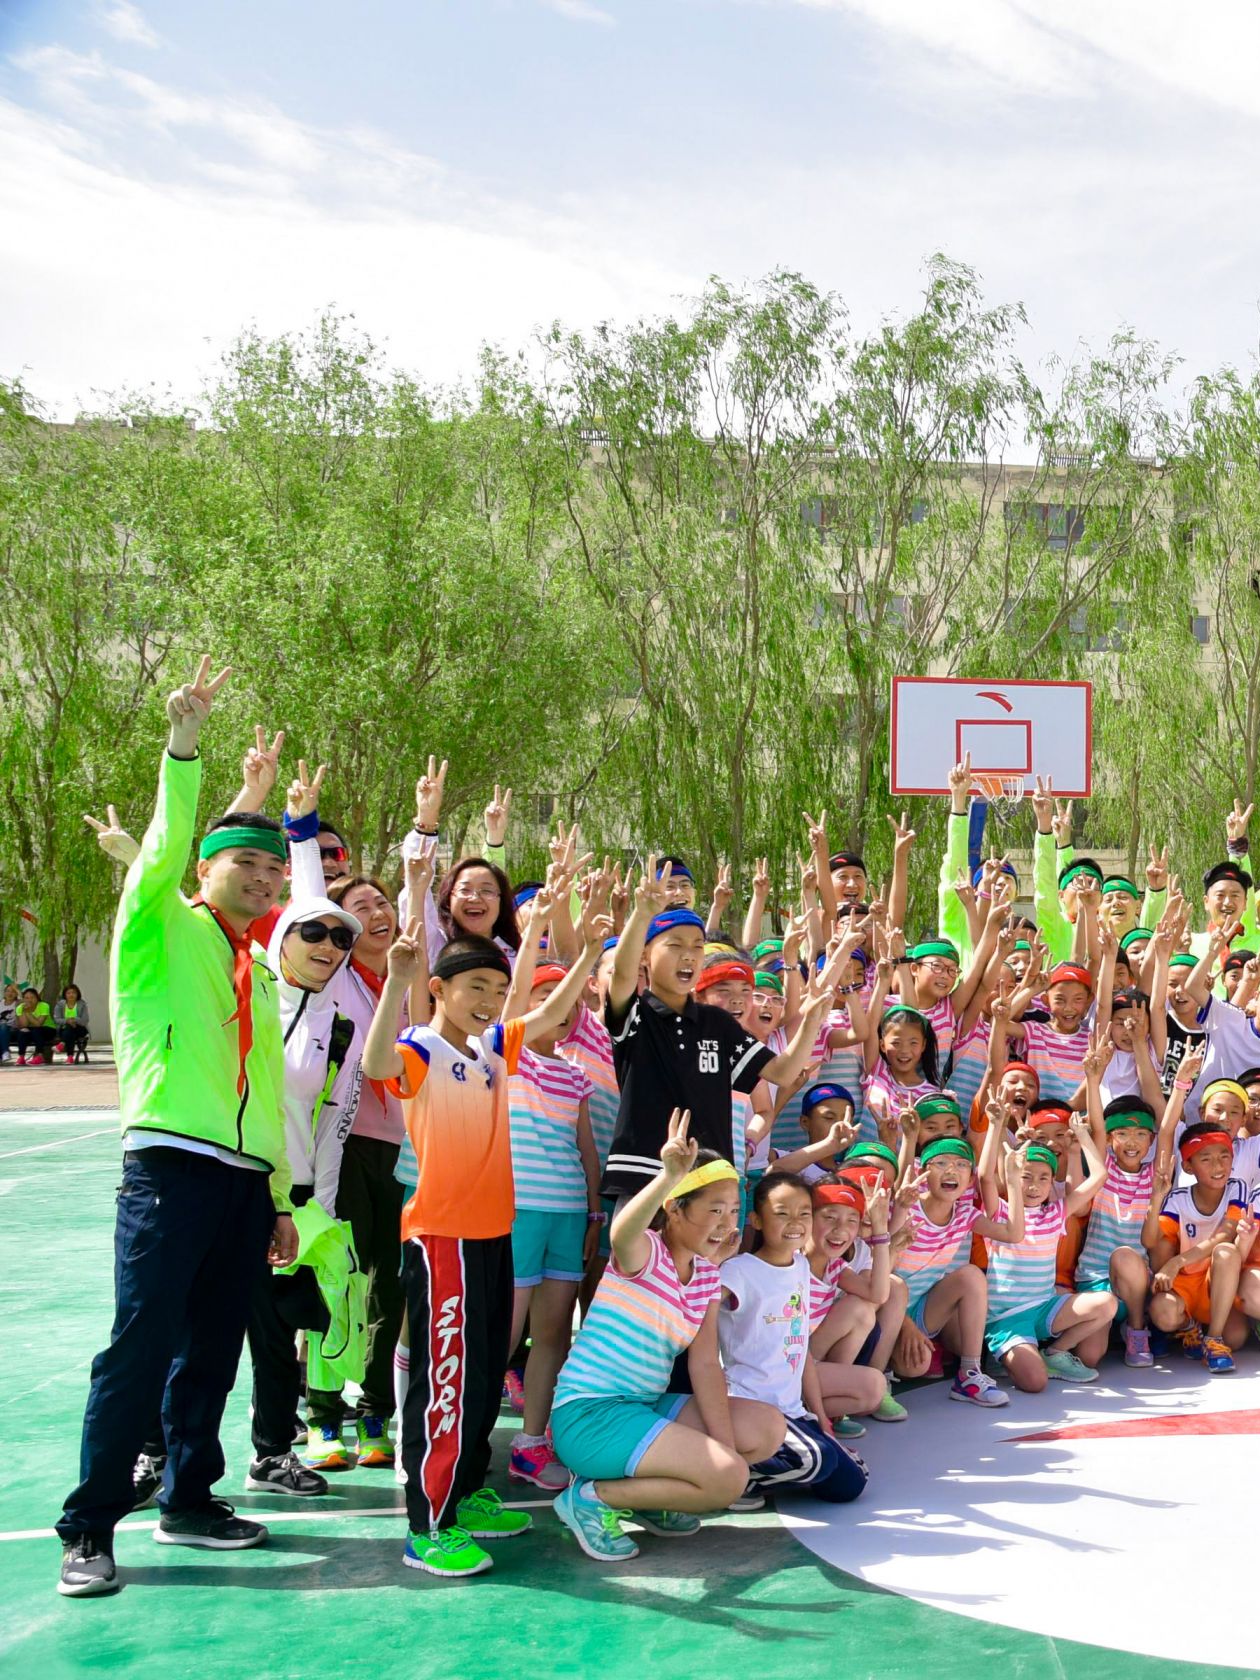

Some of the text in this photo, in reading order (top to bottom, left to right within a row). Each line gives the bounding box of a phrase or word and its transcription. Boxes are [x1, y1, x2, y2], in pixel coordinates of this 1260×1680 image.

[697, 1040, 719, 1051] LET'S
[451, 1061, 467, 1082] 9
[699, 1051, 719, 1073] GO
[1185, 1223, 1197, 1238] 9
[431, 1296, 461, 1440] STORM
